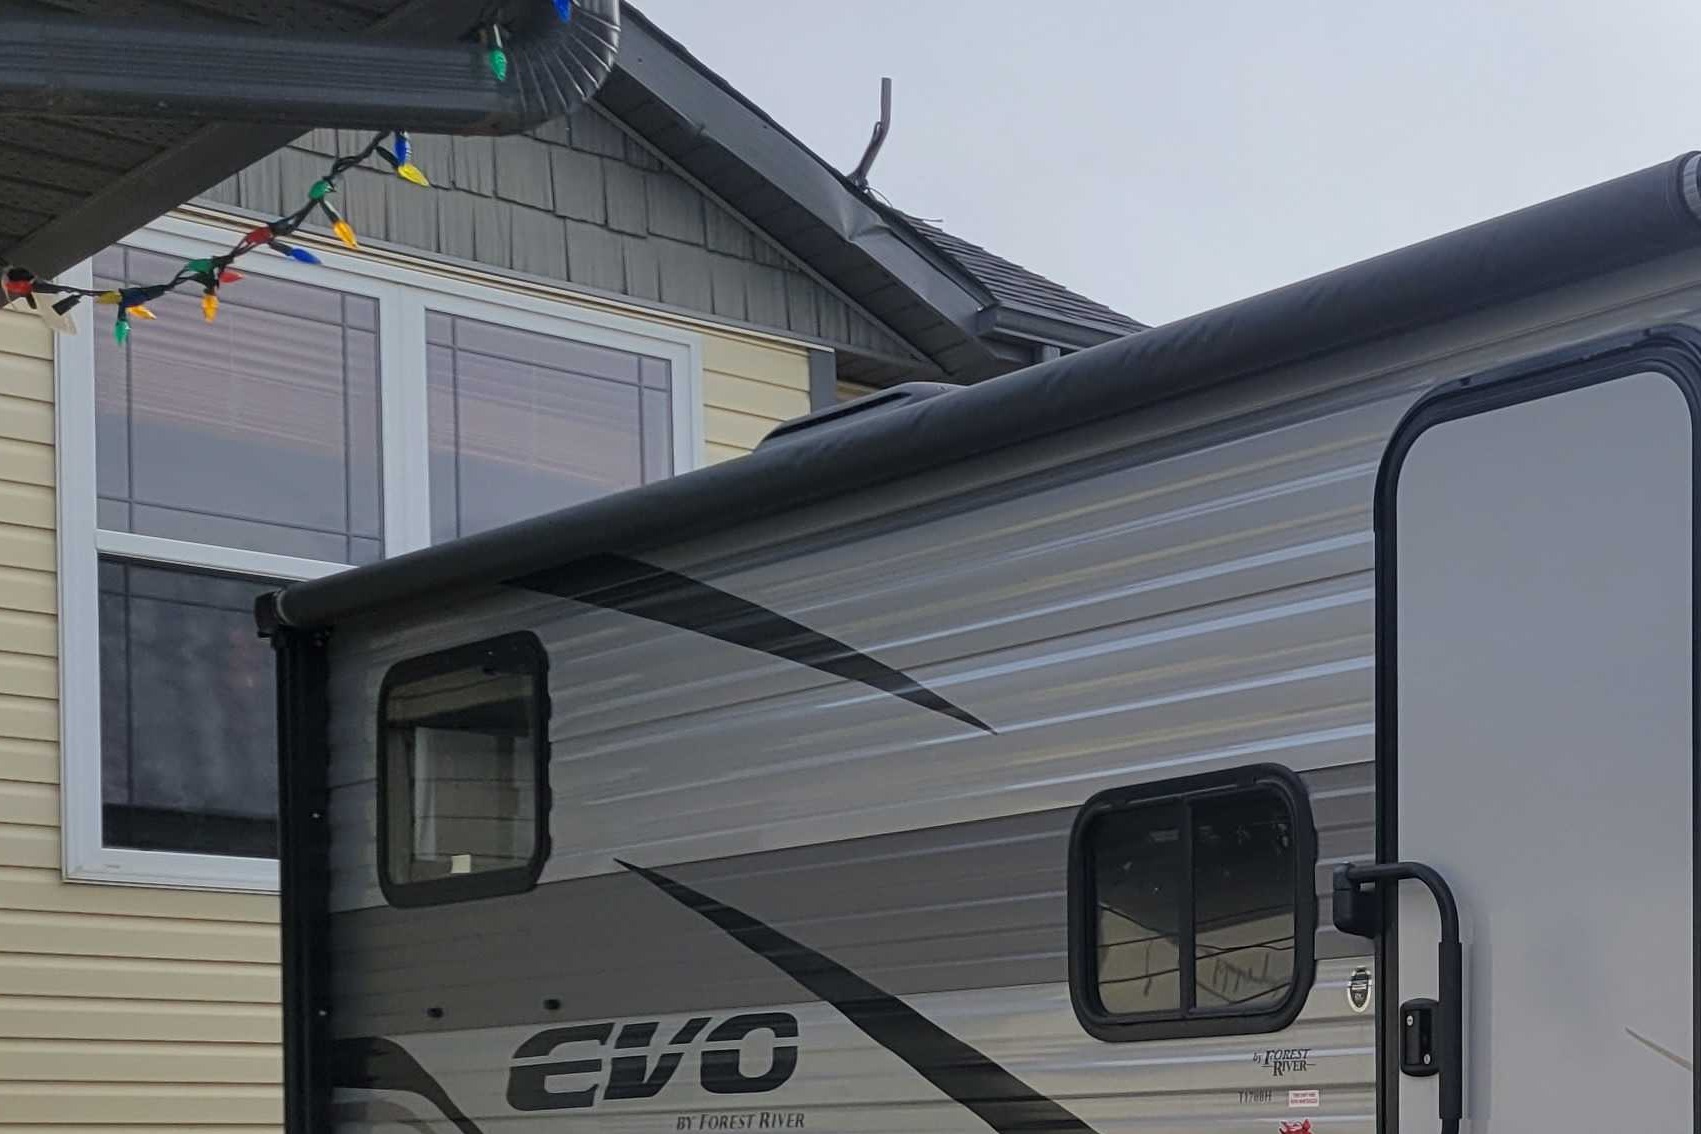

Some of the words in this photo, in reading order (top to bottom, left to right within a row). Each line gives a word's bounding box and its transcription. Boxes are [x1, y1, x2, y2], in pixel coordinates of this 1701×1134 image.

[506, 1011, 798, 1112] EVO
[676, 1115, 697, 1131] BY
[759, 1111, 806, 1129] RIVER
